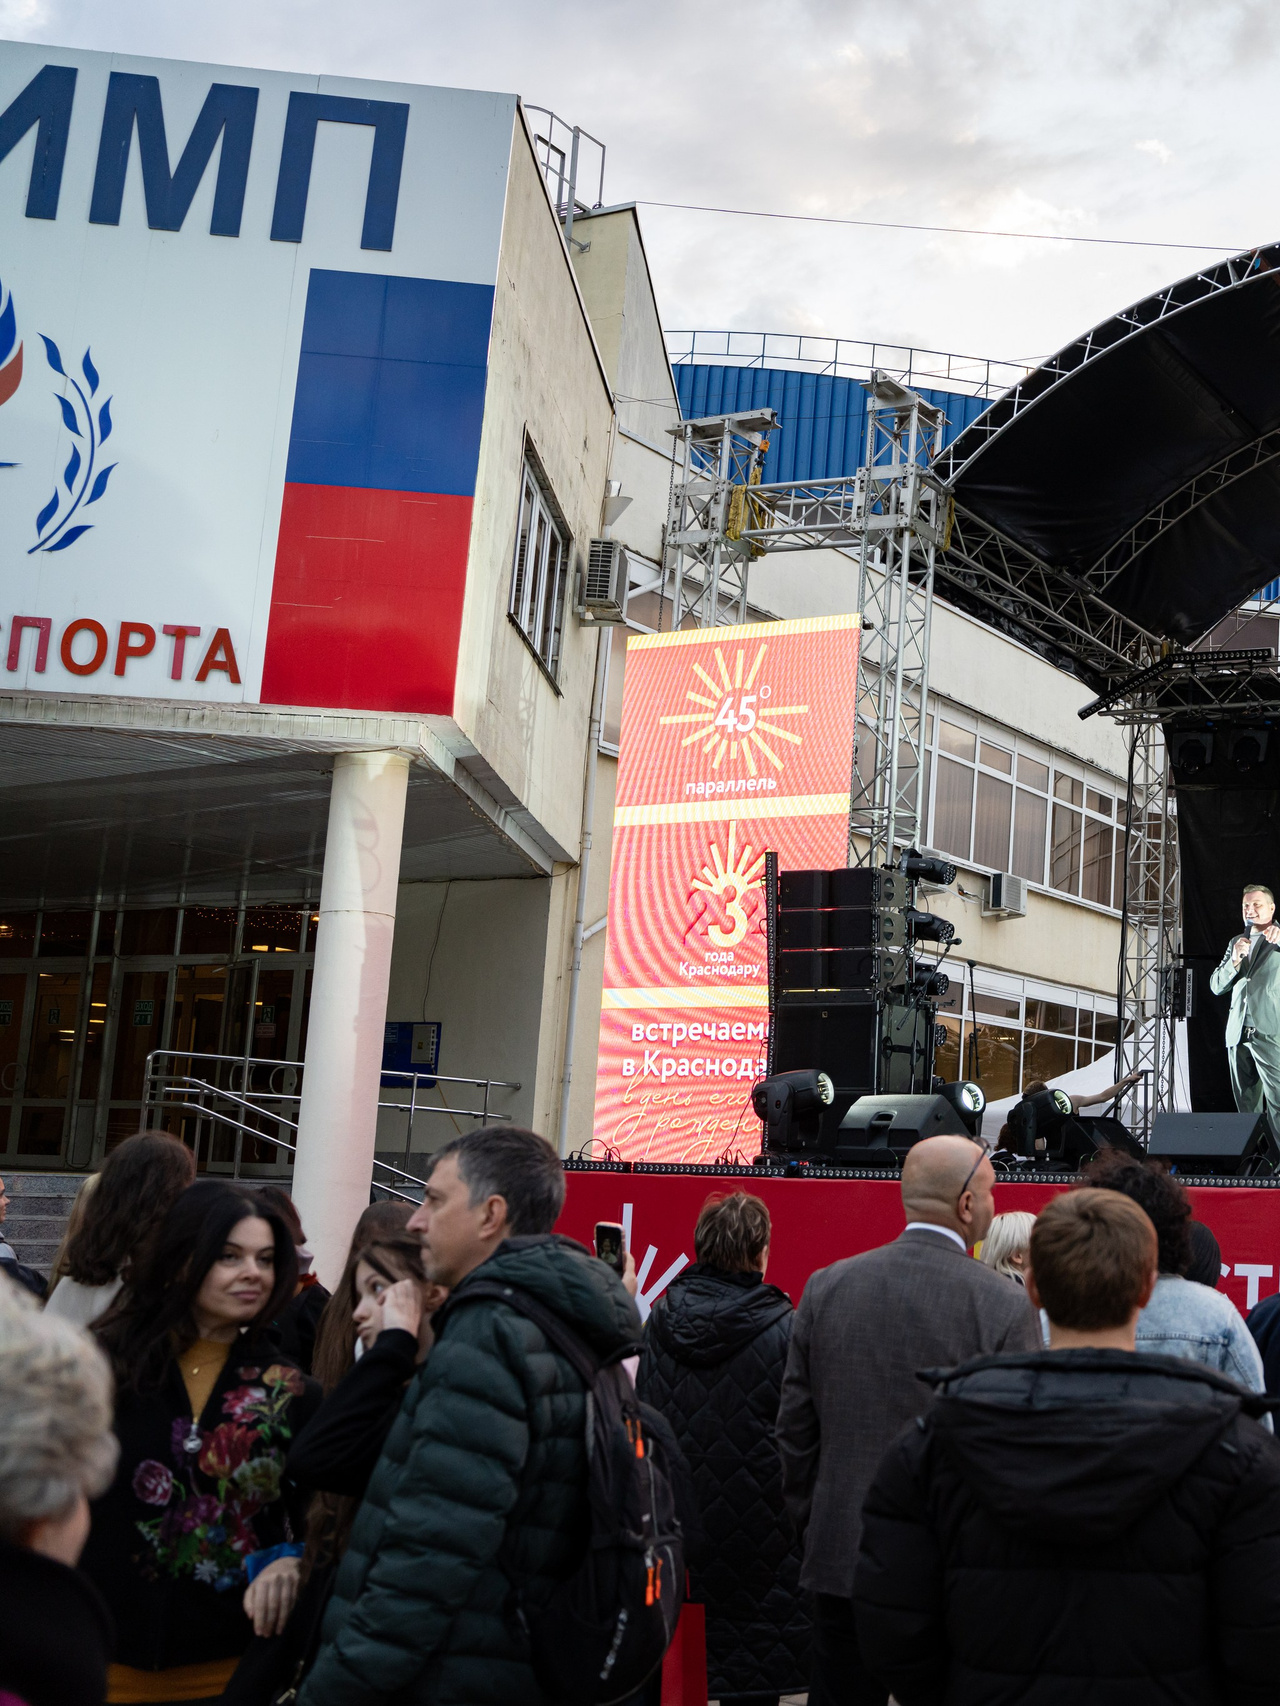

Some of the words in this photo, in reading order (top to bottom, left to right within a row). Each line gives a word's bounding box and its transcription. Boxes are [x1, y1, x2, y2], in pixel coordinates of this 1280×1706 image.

[0, 615, 241, 684] ПОРТА
[685, 778, 777, 798] параллель
[704, 951, 735, 963] года
[679, 961, 761, 978] Краснодару
[136, 1002, 153, 1011] ВХОД
[631, 1022, 769, 1047] встречаем
[622, 1058, 634, 1076] в
[612, 1092, 692, 1145] день
[709, 1093, 752, 1105] его
